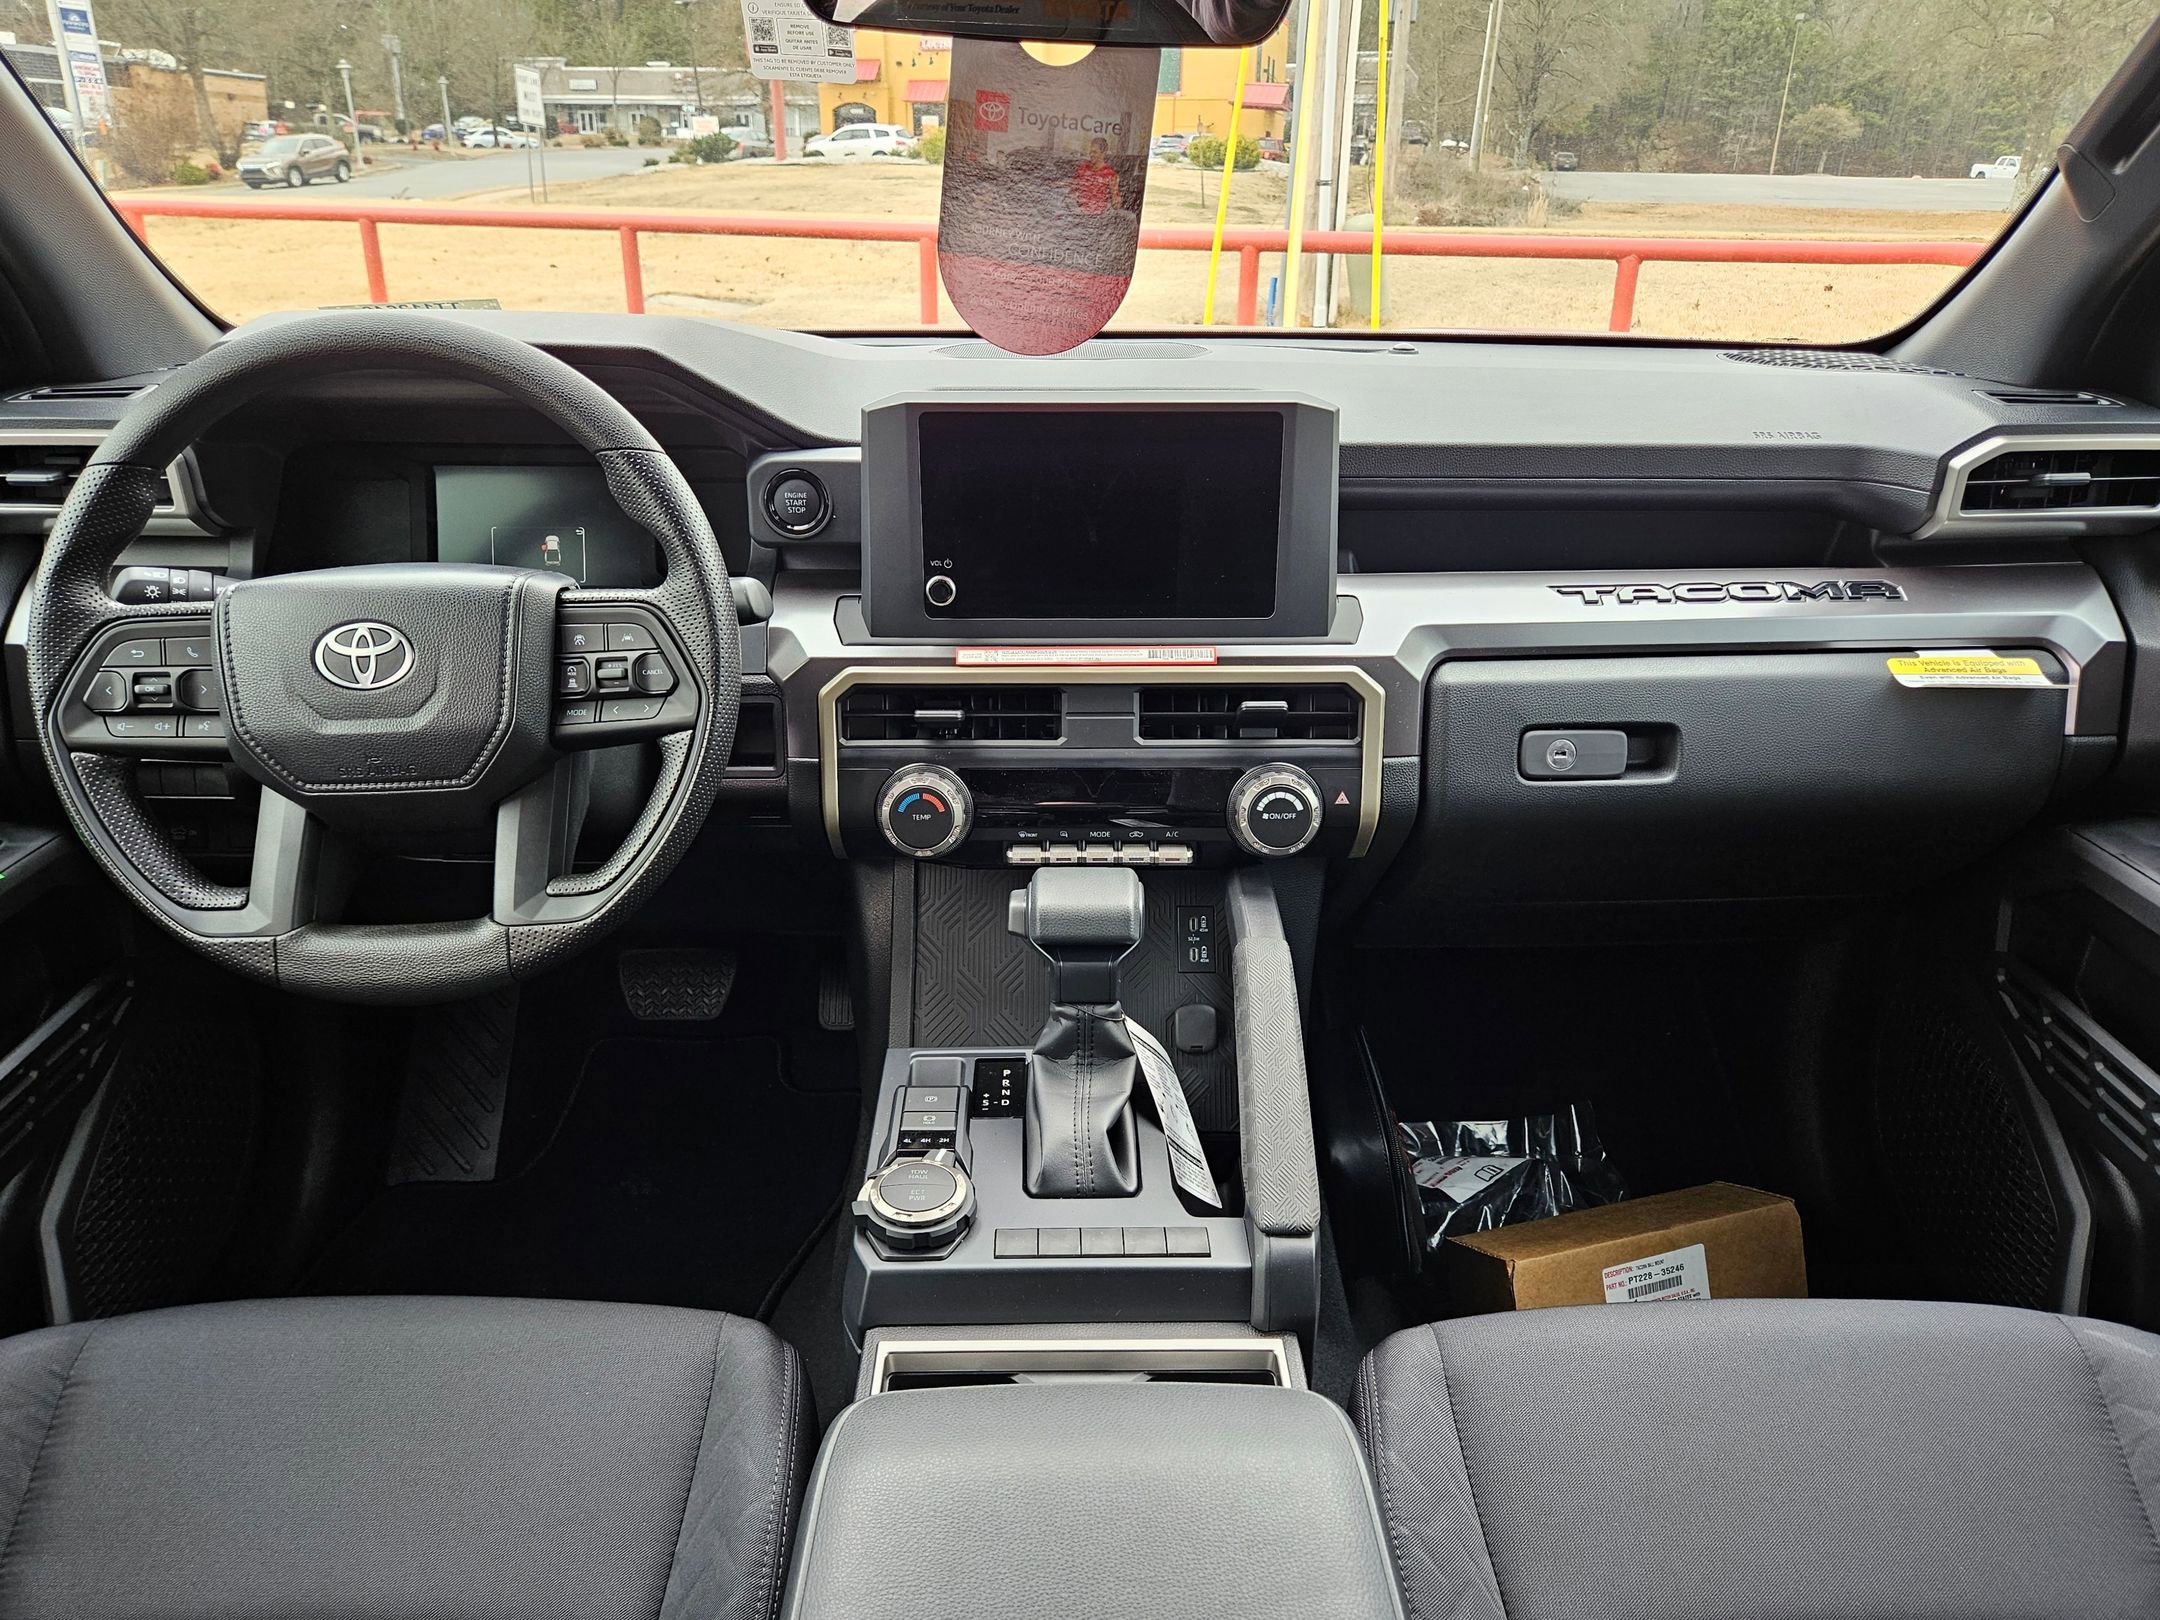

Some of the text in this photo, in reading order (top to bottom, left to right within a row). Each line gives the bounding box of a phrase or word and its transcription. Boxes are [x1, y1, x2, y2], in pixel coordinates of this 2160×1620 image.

[967, 3, 993, 14] Toyota
[994, 4, 1020, 14] Dealer
[1018, 106, 1123, 136] ToyotaCare
[1008, 242, 1104, 267] CONFIDENCE
[1776, 431, 1823, 440] AIRBAG
[785, 499, 807, 507] START
[787, 506, 806, 514] STOP
[1547, 580, 1907, 606] TACOMA
[1963, 660, 2005, 668] Equipped
[1002, 1069, 1011, 1077] P
[1002, 1079, 1010, 1087] R
[1604, 1266, 1634, 1279] DESCRIPTION:
[1606, 1282, 1617, 1291] PART
